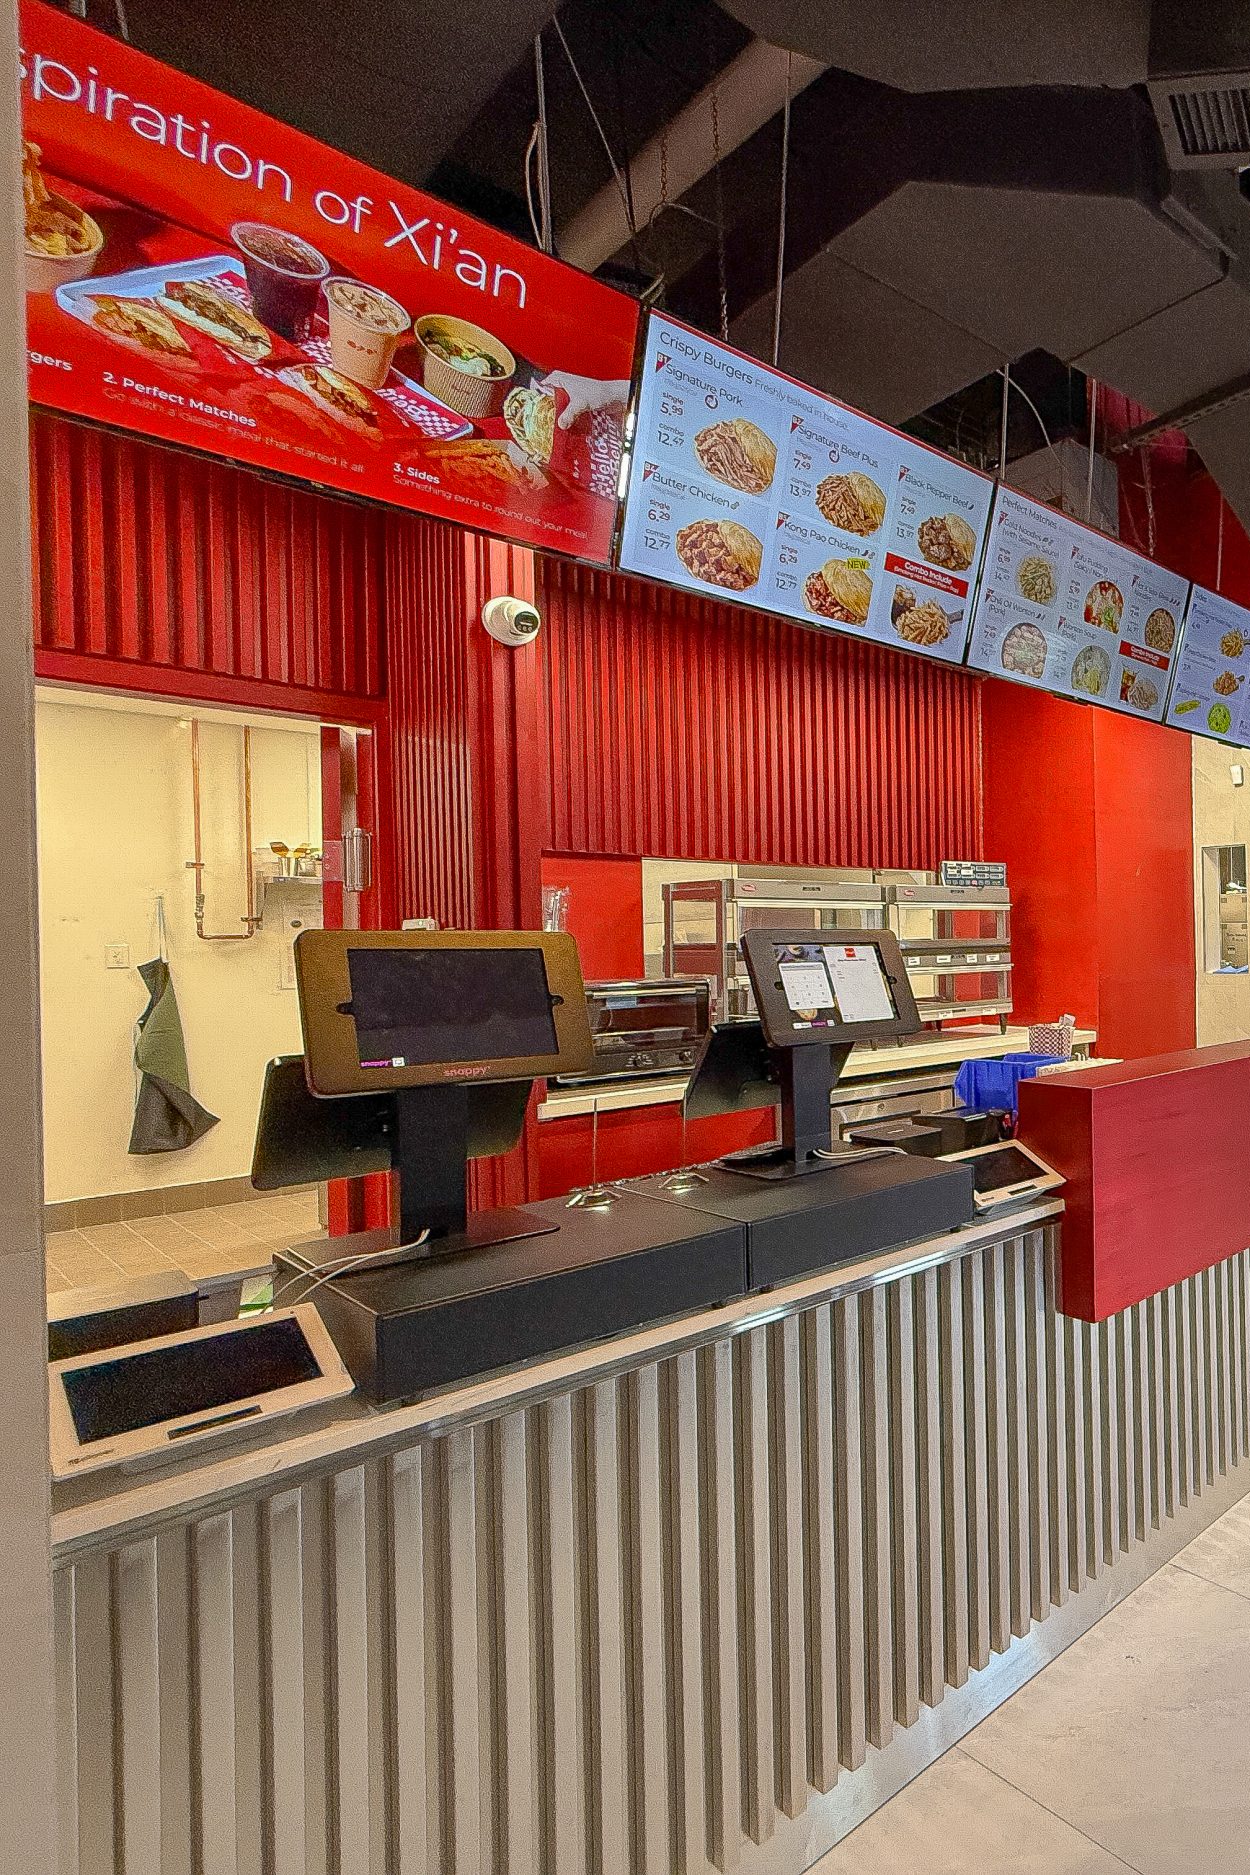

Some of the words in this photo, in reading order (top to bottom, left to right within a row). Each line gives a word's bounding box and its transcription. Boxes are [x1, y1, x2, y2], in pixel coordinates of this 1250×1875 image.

[315, 191, 373, 234] of
[384, 200, 527, 310] Xi'an
[657, 353, 667, 364] B1
[659, 329, 701, 362] Crispy
[703, 351, 752, 387] Burgers
[754, 378, 785, 402] Freshly
[786, 394, 812, 414] baked
[665, 362, 717, 396] Signature
[719, 387, 743, 407] Pork
[102, 371, 118, 385] 2.
[123, 376, 184, 406] Perfect
[189, 398, 257, 428] Matches
[662, 390, 683, 406] single
[660, 400, 683, 421] 5.99
[656, 429, 683, 451] 12.47
[658, 421, 684, 438] combo
[797, 424, 839, 452] Signature
[841, 444, 859, 460] Beef
[265, 434, 288, 451] that
[293, 443, 336, 465] started
[350, 461, 363, 473] all
[393, 462, 403, 474] 3.
[407, 466, 439, 484] Sides
[792, 457, 810, 474] 7.49
[652, 471, 686, 492] Butter
[688, 484, 730, 508] Chicken
[905, 473, 925, 490] Black
[926, 483, 951, 503] Pepper
[952, 495, 968, 509] Beef
[392, 473, 451, 501] Something
[454, 493, 479, 508] extra
[481, 501, 493, 512] to
[495, 504, 522, 521] round
[524, 514, 541, 527] out
[541, 520, 561, 534] your
[649, 497, 670, 511] single
[1002, 495, 1027, 515] Perfect
[1028, 508, 1057, 530] Matches
[647, 507, 670, 526] 6.29
[645, 526, 670, 540] combo
[784, 519, 807, 538] Kong
[809, 529, 827, 543] Pao
[827, 535, 859, 555] Chicken
[1018, 524, 1041, 541] Noodles
[643, 535, 669, 553] 12.77
[847, 560, 867, 570] NEW
[904, 561, 928, 576] Combo
[928, 570, 952, 585] Include
[360, 1059, 392, 1068] snappy
[443, 1066, 489, 1077] snappy
